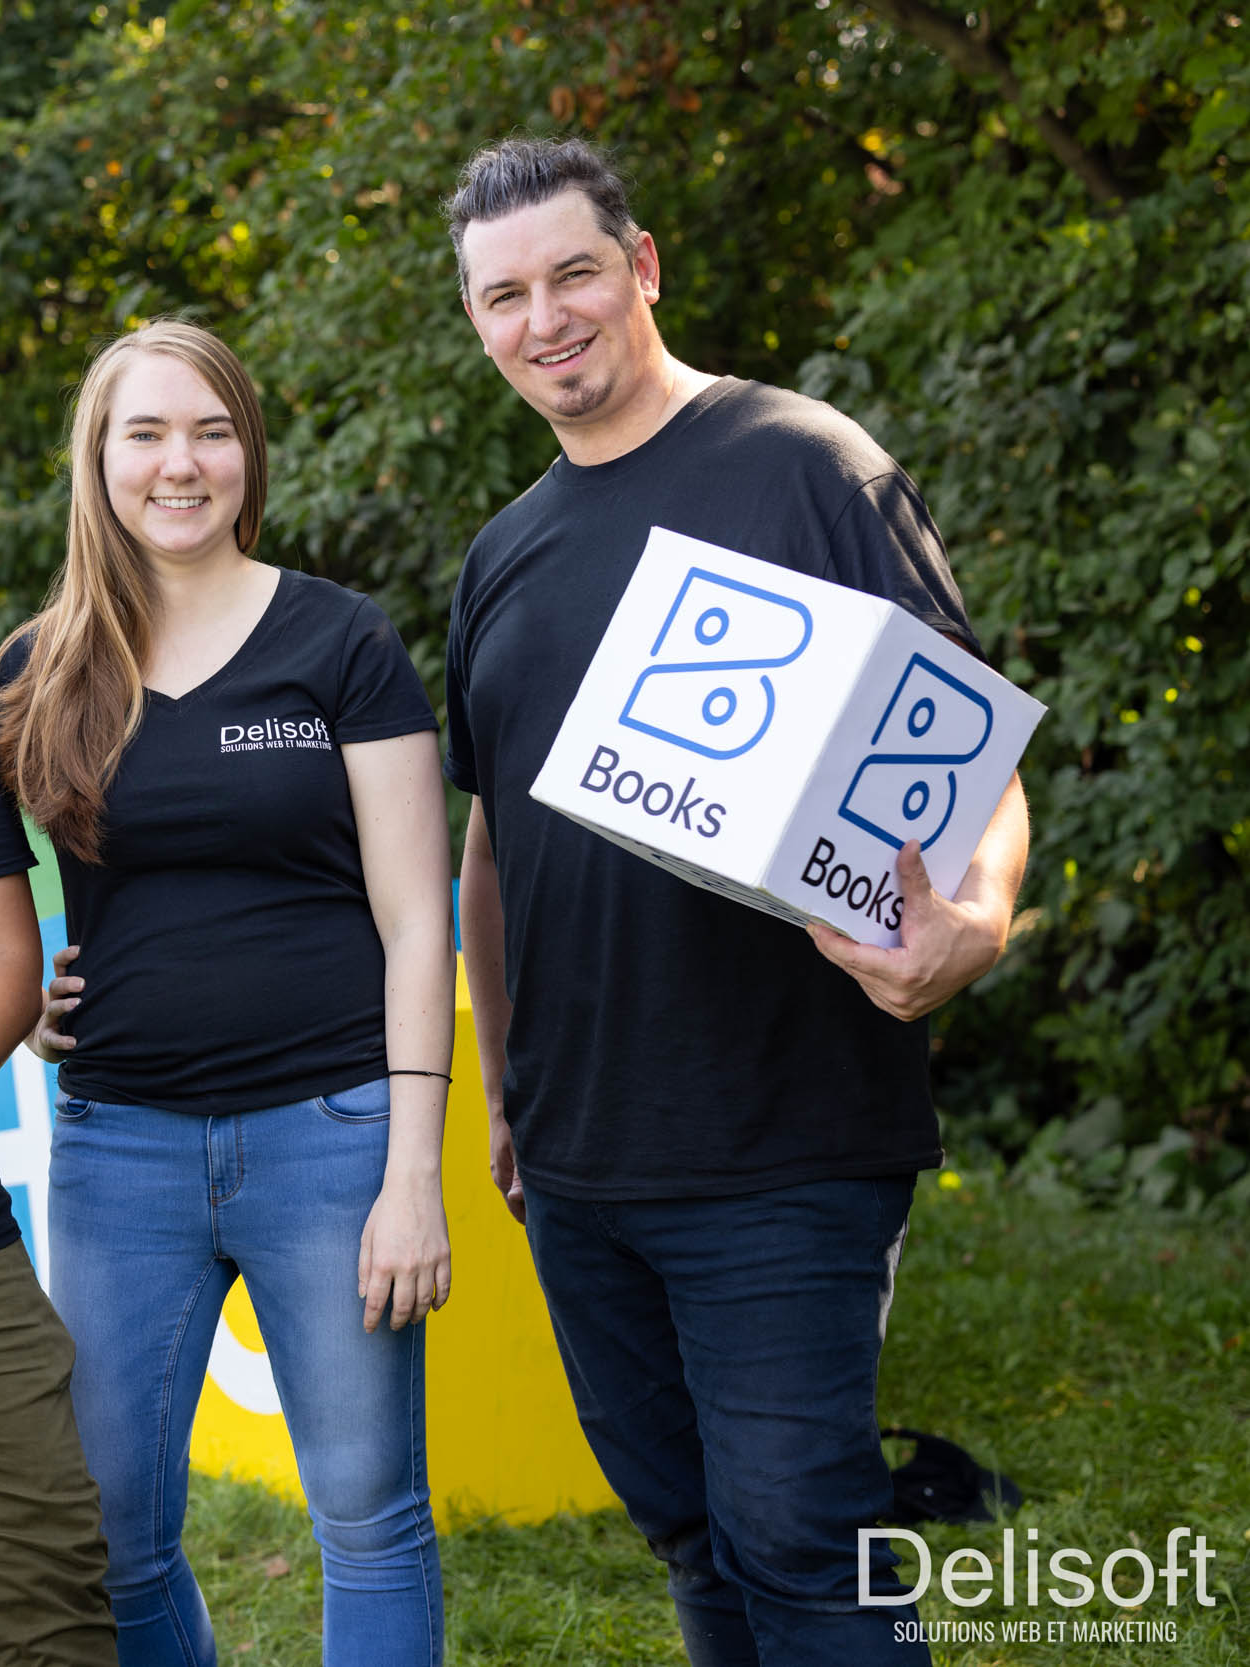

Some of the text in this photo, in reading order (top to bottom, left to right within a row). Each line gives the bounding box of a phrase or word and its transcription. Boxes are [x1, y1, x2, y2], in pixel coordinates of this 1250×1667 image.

[220, 740, 332, 753] SOLUTIONS WEB ET MARKETING
[221, 718, 330, 745] Delisoft
[579, 745, 728, 838] Books
[800, 836, 905, 931] Books
